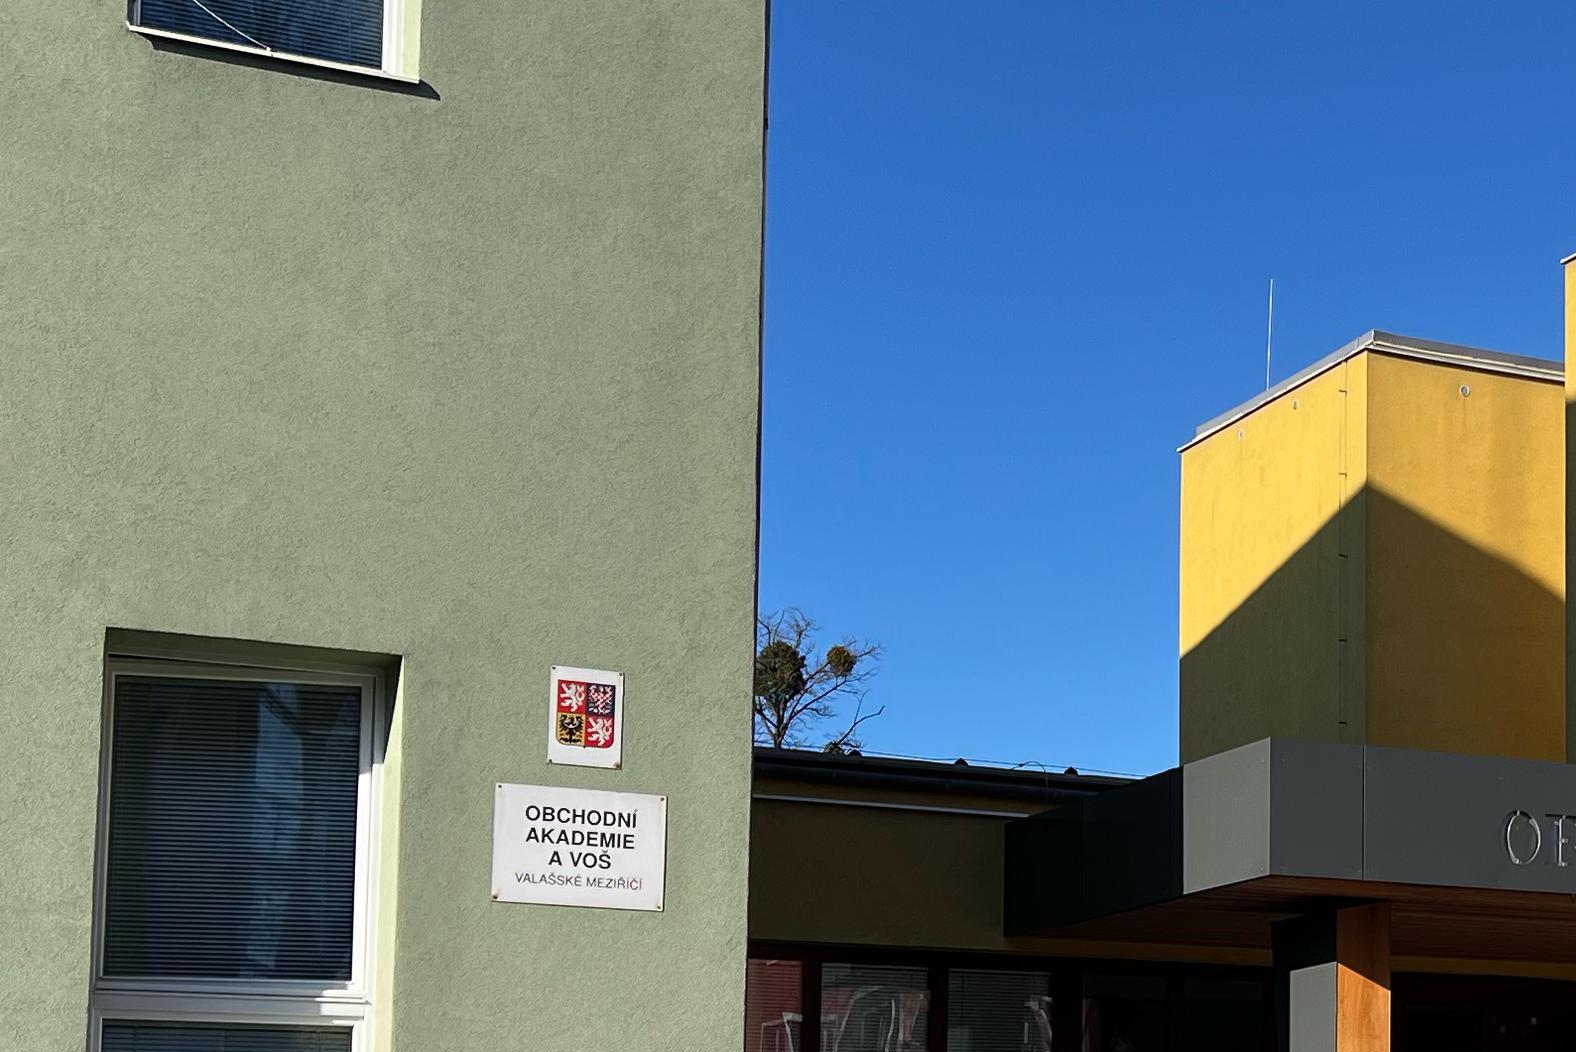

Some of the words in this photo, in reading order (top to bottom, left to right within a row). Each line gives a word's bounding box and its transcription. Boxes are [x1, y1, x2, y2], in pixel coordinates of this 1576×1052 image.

[525, 805, 639, 829] OBCHODNÍ
[525, 827, 636, 850] AKADEMIE
[548, 850, 563, 866] A
[569, 849, 612, 870] VOŠ
[514, 871, 583, 888] VALAŠSKÉ
[586, 875, 643, 891] MEZIŘÍČÍ
